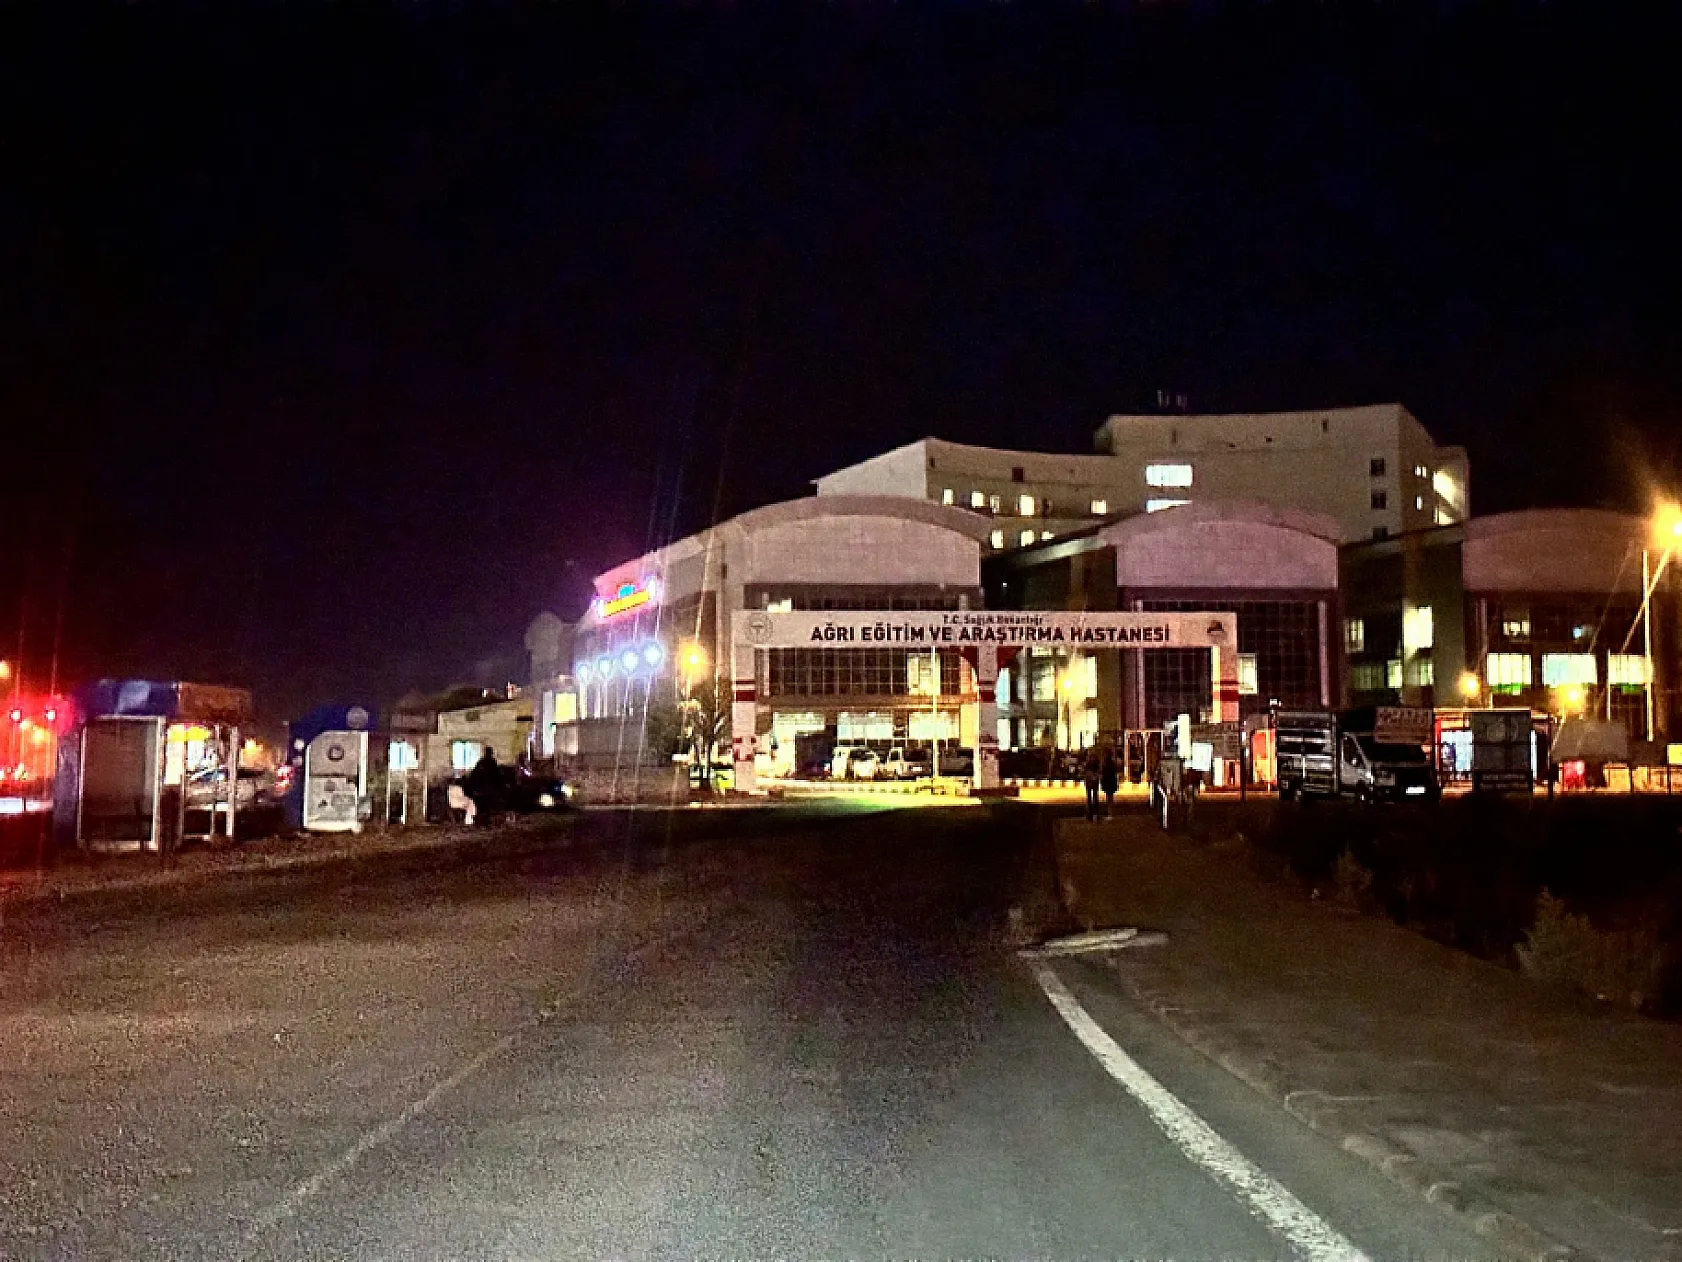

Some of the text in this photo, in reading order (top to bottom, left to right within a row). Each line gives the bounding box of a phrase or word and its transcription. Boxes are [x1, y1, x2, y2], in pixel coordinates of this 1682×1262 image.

[811, 621, 1170, 645] AĞRI EĞİTİM VE ARAŞTIRMA HASTANESİ
